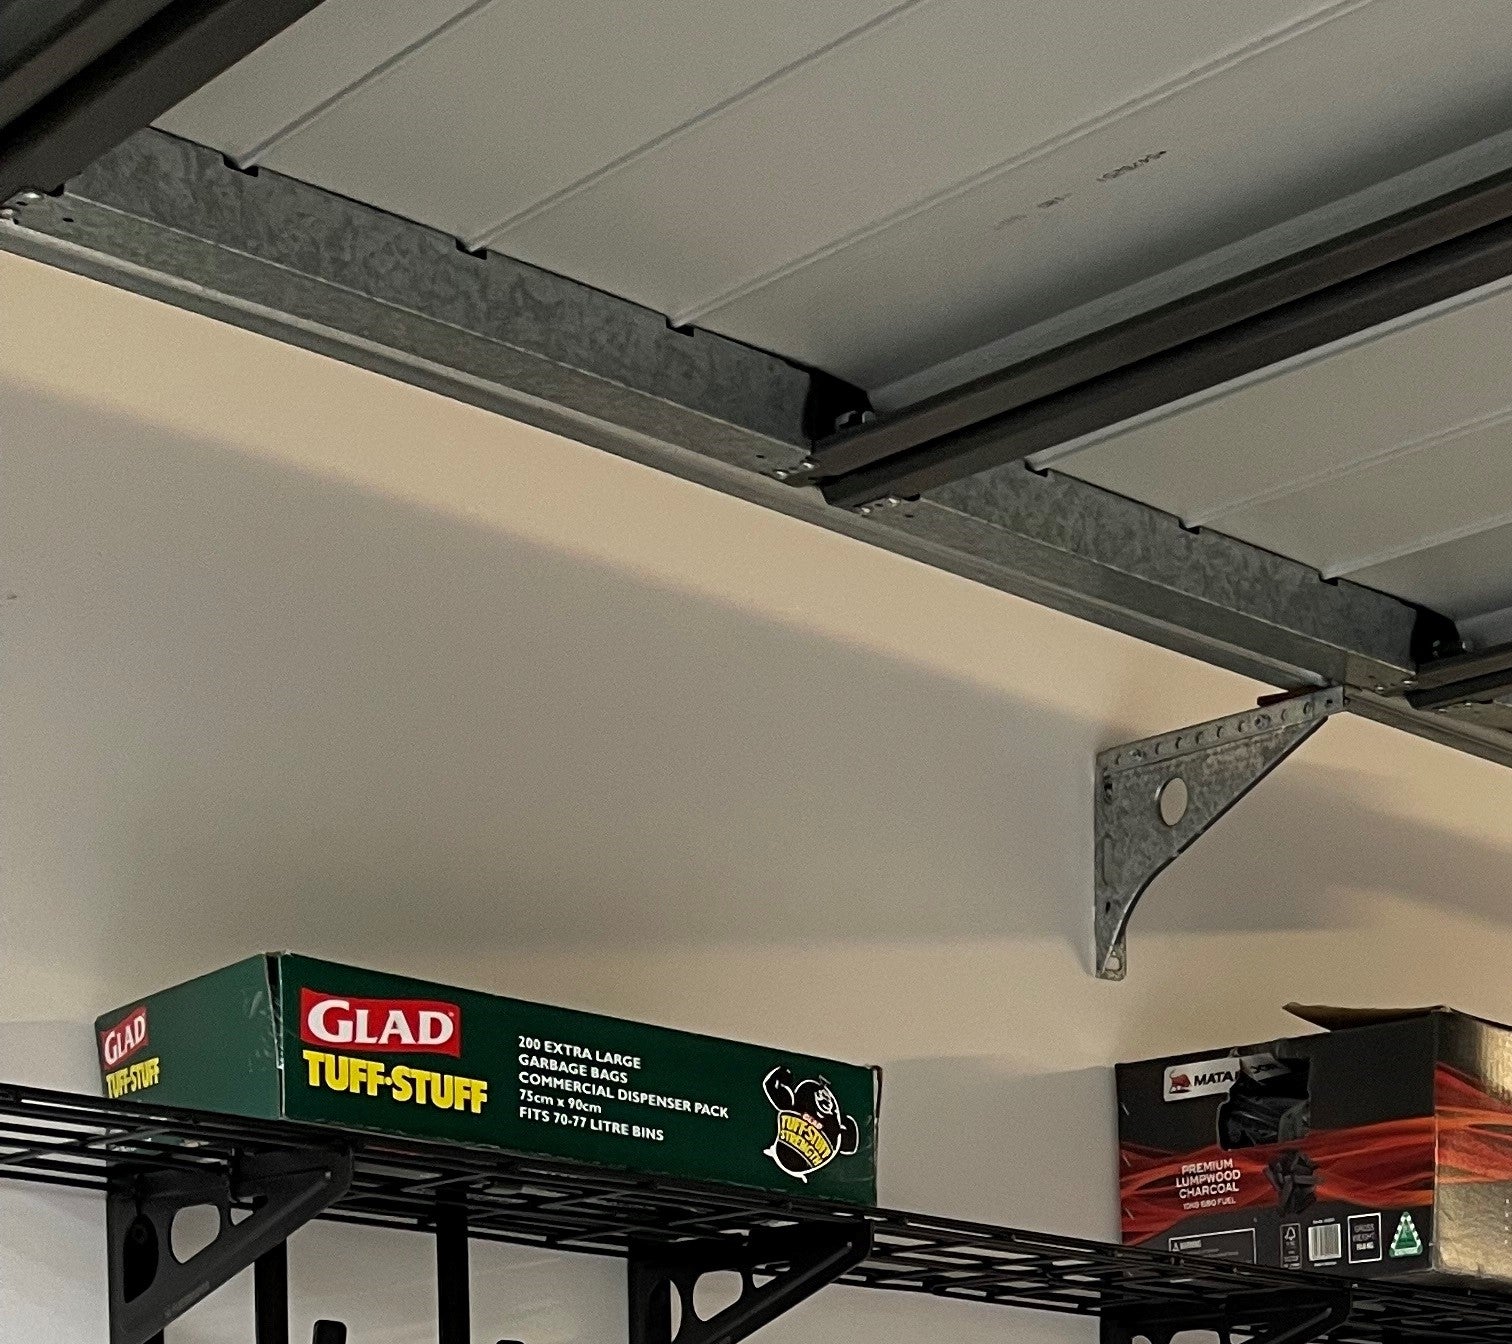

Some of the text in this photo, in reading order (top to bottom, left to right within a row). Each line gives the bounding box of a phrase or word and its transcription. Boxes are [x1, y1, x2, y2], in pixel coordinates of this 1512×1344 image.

[308, 999, 454, 1046] GLAD
[104, 1014, 147, 1066] GLAD
[518, 1035, 642, 1070] 200 EXTRA LARGE
[518, 1053, 629, 1084] GARBAGE BAGS
[1194, 1070, 1240, 1087] MATA
[518, 1071, 729, 1119] COMMERCIAL DISPENSER PACK
[519, 1088, 602, 1114] 75cm x 90cm
[519, 1106, 665, 1141] FITS 70-77 LITRE BINS
[1175, 1169, 1241, 1188] LUMPWOOD
[1181, 1158, 1234, 1175] PREMIUM
[1179, 1181, 1240, 1199] CHARCOAL
[1217, 1196, 1236, 1206] FUEL
